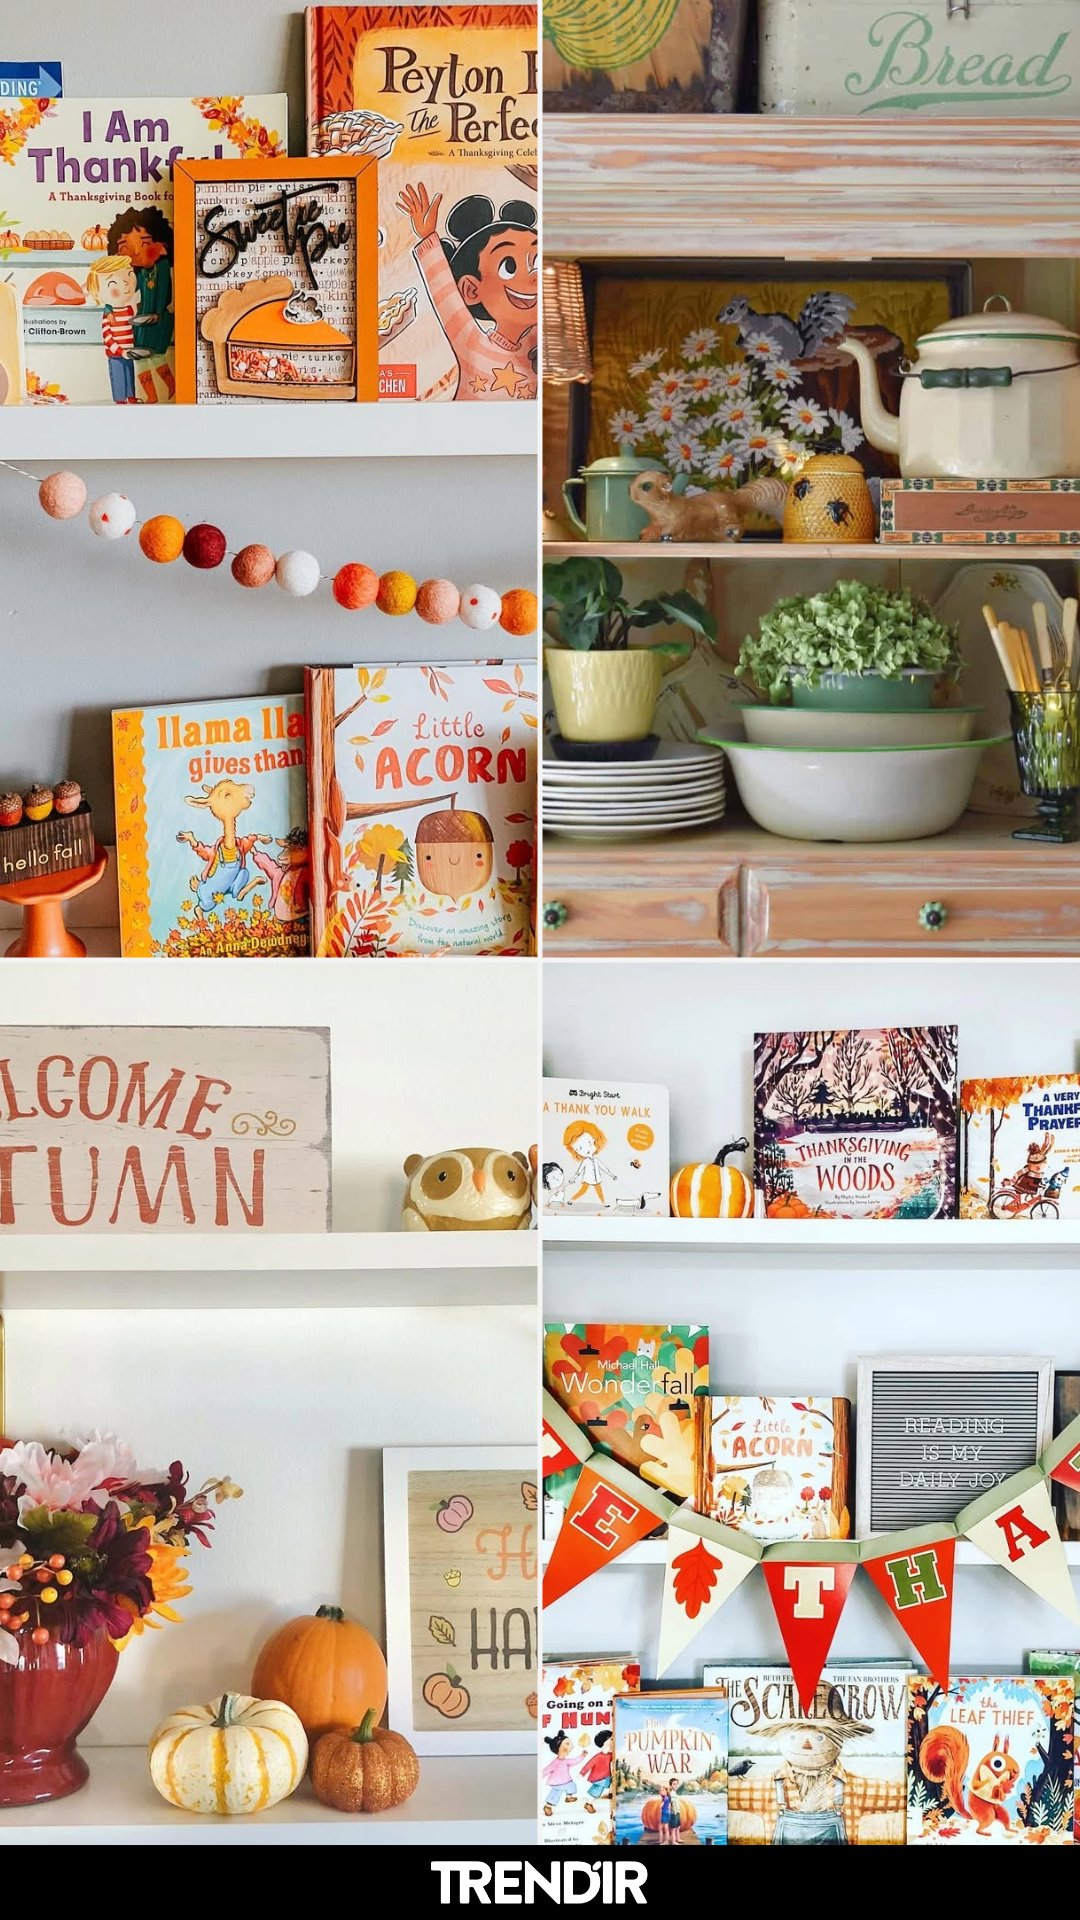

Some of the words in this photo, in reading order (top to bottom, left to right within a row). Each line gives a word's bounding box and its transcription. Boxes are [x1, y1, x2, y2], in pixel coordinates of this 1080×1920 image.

[845, 11, 1071, 112] Bread
[374, 46, 505, 104] Peyton
[0, 81, 38, 96] DING
[83, 111, 91, 142] I
[105, 110, 169, 143] Am
[407, 108, 440, 133] The
[458, 148, 514, 159] Thanksgiving
[28, 145, 223, 184] Thankf
[248, 183, 266, 193] pie
[49, 192, 56, 201] A
[60, 191, 131, 205] Thanksgiving
[135, 191, 161, 201] Book
[28, 327, 86, 335] Clifton-Brown
[308, 354, 349, 362] turkey
[379, 379, 406, 393] CHEN
[157, 713, 251, 749] llama
[413, 711, 485, 740] Little
[188, 750, 250, 783] gives
[254, 748, 304, 773] than
[375, 745, 528, 790] ACORN
[4, 850, 49, 874] hello
[54, 838, 83, 861] fall
[408, 916, 443, 933] Discover
[459, 923, 489, 934] amazing
[491, 913, 512, 927] story
[216, 940, 247, 954] Anna
[251, 933, 307, 949] Dewdney
[417, 934, 434, 945] from
[437, 937, 451, 946] the
[453, 936, 481, 947] natural
[579, 1089, 602, 1100] Bright
[603, 1090, 621, 1099] Start
[1043, 1093, 1050, 1102] A
[1053, 1091, 1080, 1101] VERY
[542, 1101, 550, 1113] A
[554, 1102, 591, 1115] THANK
[594, 1104, 617, 1116] YOU
[620, 1106, 651, 1118] WALK
[795, 1136, 912, 1163] THANKSGIVING
[844, 1156, 853, 1164] IN
[816, 1162, 896, 1192] WOODS
[597, 1360, 637, 1371] Michael
[640, 1359, 660, 1371] Hall
[561, 1371, 695, 1395] Wonderfall
[753, 1418, 792, 1434] Little
[904, 1417, 1005, 1434] READING
[732, 1436, 813, 1459] ACORN
[921, 1445, 940, 1461] IS
[951, 1445, 984, 1461] MY
[899, 1472, 960, 1488] DAILY
[968, 1472, 1007, 1488] JOY
[763, 1674, 780, 1682] BETH
[715, 1676, 742, 1698] THE
[546, 1700, 584, 1710] Going
[588, 1700, 603, 1708] on
[980, 1696, 998, 1709] the
[950, 1708, 986, 1725] LEAF
[992, 1710, 1034, 1726] THIEF
[624, 1729, 715, 1751] PUMPKIN
[647, 1751, 692, 1773] WAR
